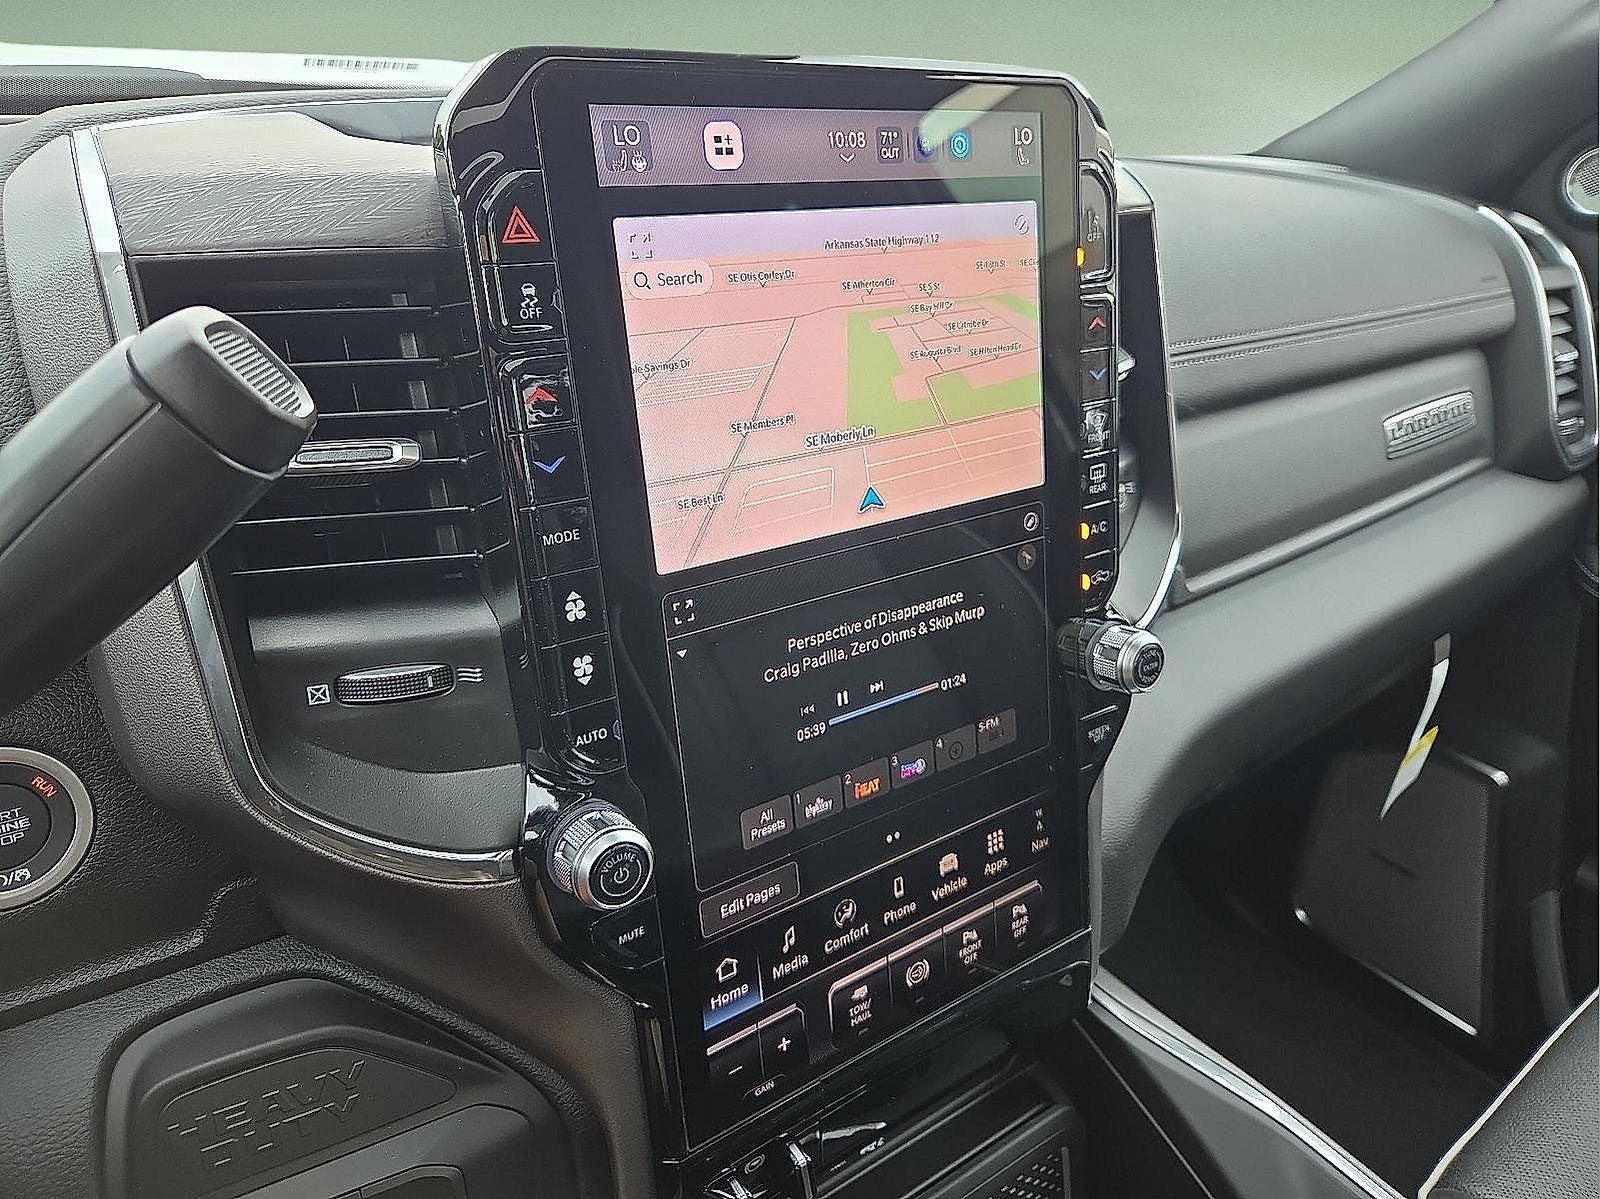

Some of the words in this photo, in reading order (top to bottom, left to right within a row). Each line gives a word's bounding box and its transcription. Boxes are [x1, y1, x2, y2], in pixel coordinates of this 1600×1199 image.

[612, 124, 641, 146] LO
[827, 131, 867, 149] 10:08
[880, 131, 899, 145] 71°
[1013, 127, 1034, 146] LO
[880, 147, 900, 160] OUT
[824, 239, 864, 250] Arkansas
[864, 237, 887, 248] State
[887, 235, 924, 248] Highway
[925, 233, 940, 244] 112
[656, 269, 703, 287] Search
[728, 273, 738, 283] SE
[785, 269, 795, 279] Dr
[842, 281, 852, 290] SE
[918, 283, 926, 292] SE
[519, 307, 543, 320] OFF
[910, 304, 919, 313] SE
[644, 361, 679, 373] Savings
[680, 359, 690, 369] Dr
[731, 422, 742, 434] SE
[746, 417, 784, 432] Members
[805, 436, 819, 448] SE
[820, 428, 861, 445] Moberly
[861, 426, 874, 439] Ln
[1088, 482, 1107, 495] REAR
[677, 499, 689, 510] SE
[691, 495, 711, 508] Best
[713, 493, 724, 505] Ln
[1090, 520, 1109, 536] A/C
[542, 528, 580, 547] MODE
[787, 622, 862, 652] Perspective
[864, 616, 878, 630] of
[878, 590, 964, 626] Disappearance
[763, 660, 800, 683] Craig
[802, 649, 849, 672] Padilla,
[850, 637, 880, 657] Zero
[880, 626, 917, 645] Ohms
[917, 622, 929, 636] &
[928, 614, 954, 632] Skip
[954, 604, 986, 625] Murp
[940, 673, 967, 692] 01:24
[575, 727, 608, 747] AUTO
[796, 721, 827, 742] 05:39
[935, 737, 943, 749] 4
[891, 755, 898, 766] 3
[31, 775, 58, 799] RUN
[844, 774, 852, 785] 2
[854, 777, 880, 799] HEAT
[760, 808, 773, 823] All
[750, 817, 786, 840] Presets
[1031, 837, 1050, 854] Nav
[600, 851, 638, 874] VOLUME
[984, 856, 1009, 877] Apps
[931, 876, 968, 902] Vehicle
[720, 899, 745, 919] Edit
[746, 883, 781, 907] Pages
[883, 901, 917, 926] Phone
[1011, 915, 1030, 932] REAR
[618, 925, 646, 946] MUTE
[824, 922, 870, 955] Comfort
[1013, 926, 1027, 940] OFF
[958, 939, 983, 960] FRONT
[963, 951, 979, 966] OFF
[772, 953, 809, 981] Media
[709, 982, 749, 1010] Home
[849, 998, 872, 1018] TOW/
[850, 1010, 873, 1028] HAUL
[754, 1080, 775, 1097] GAIN
